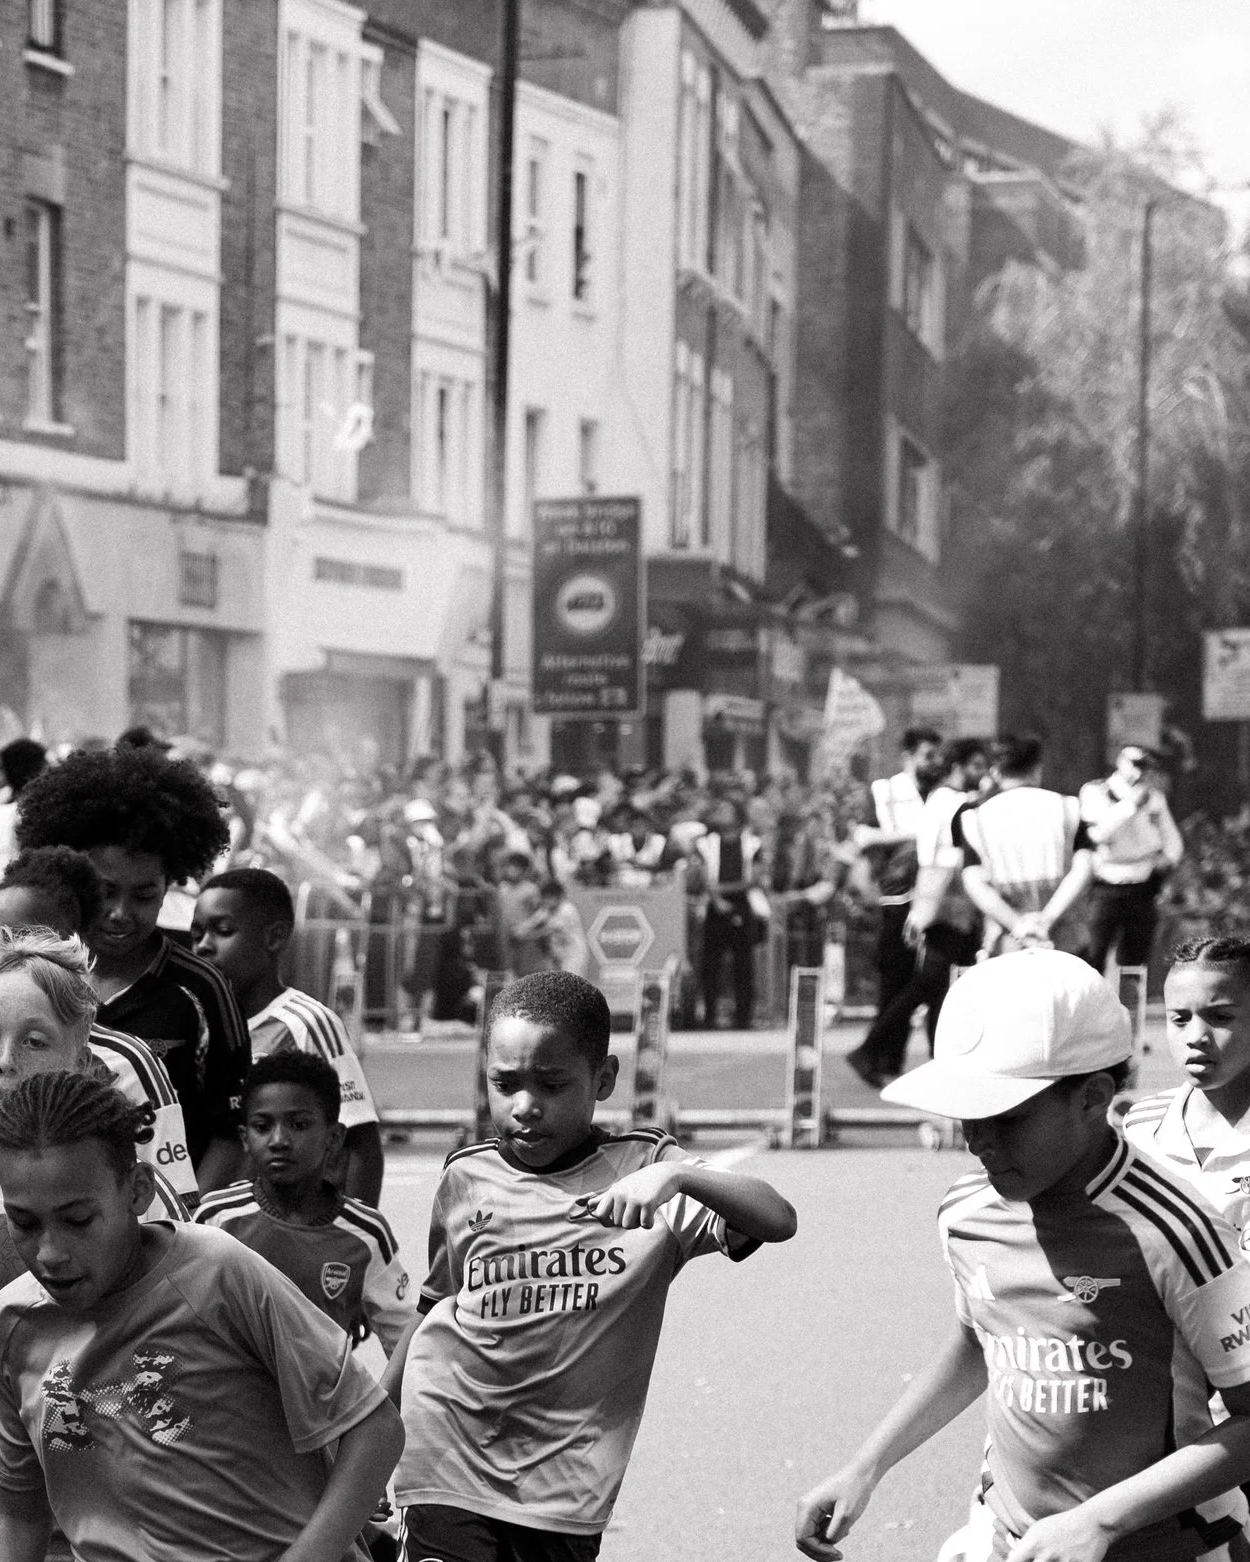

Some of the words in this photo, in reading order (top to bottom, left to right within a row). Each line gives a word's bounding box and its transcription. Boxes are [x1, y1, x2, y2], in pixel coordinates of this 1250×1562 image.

[468, 1242, 626, 1292] Emirates
[480, 1287, 512, 1319] FLY
[519, 1283, 599, 1314] BETTER
[1019, 1377, 1108, 1413] BETTER
